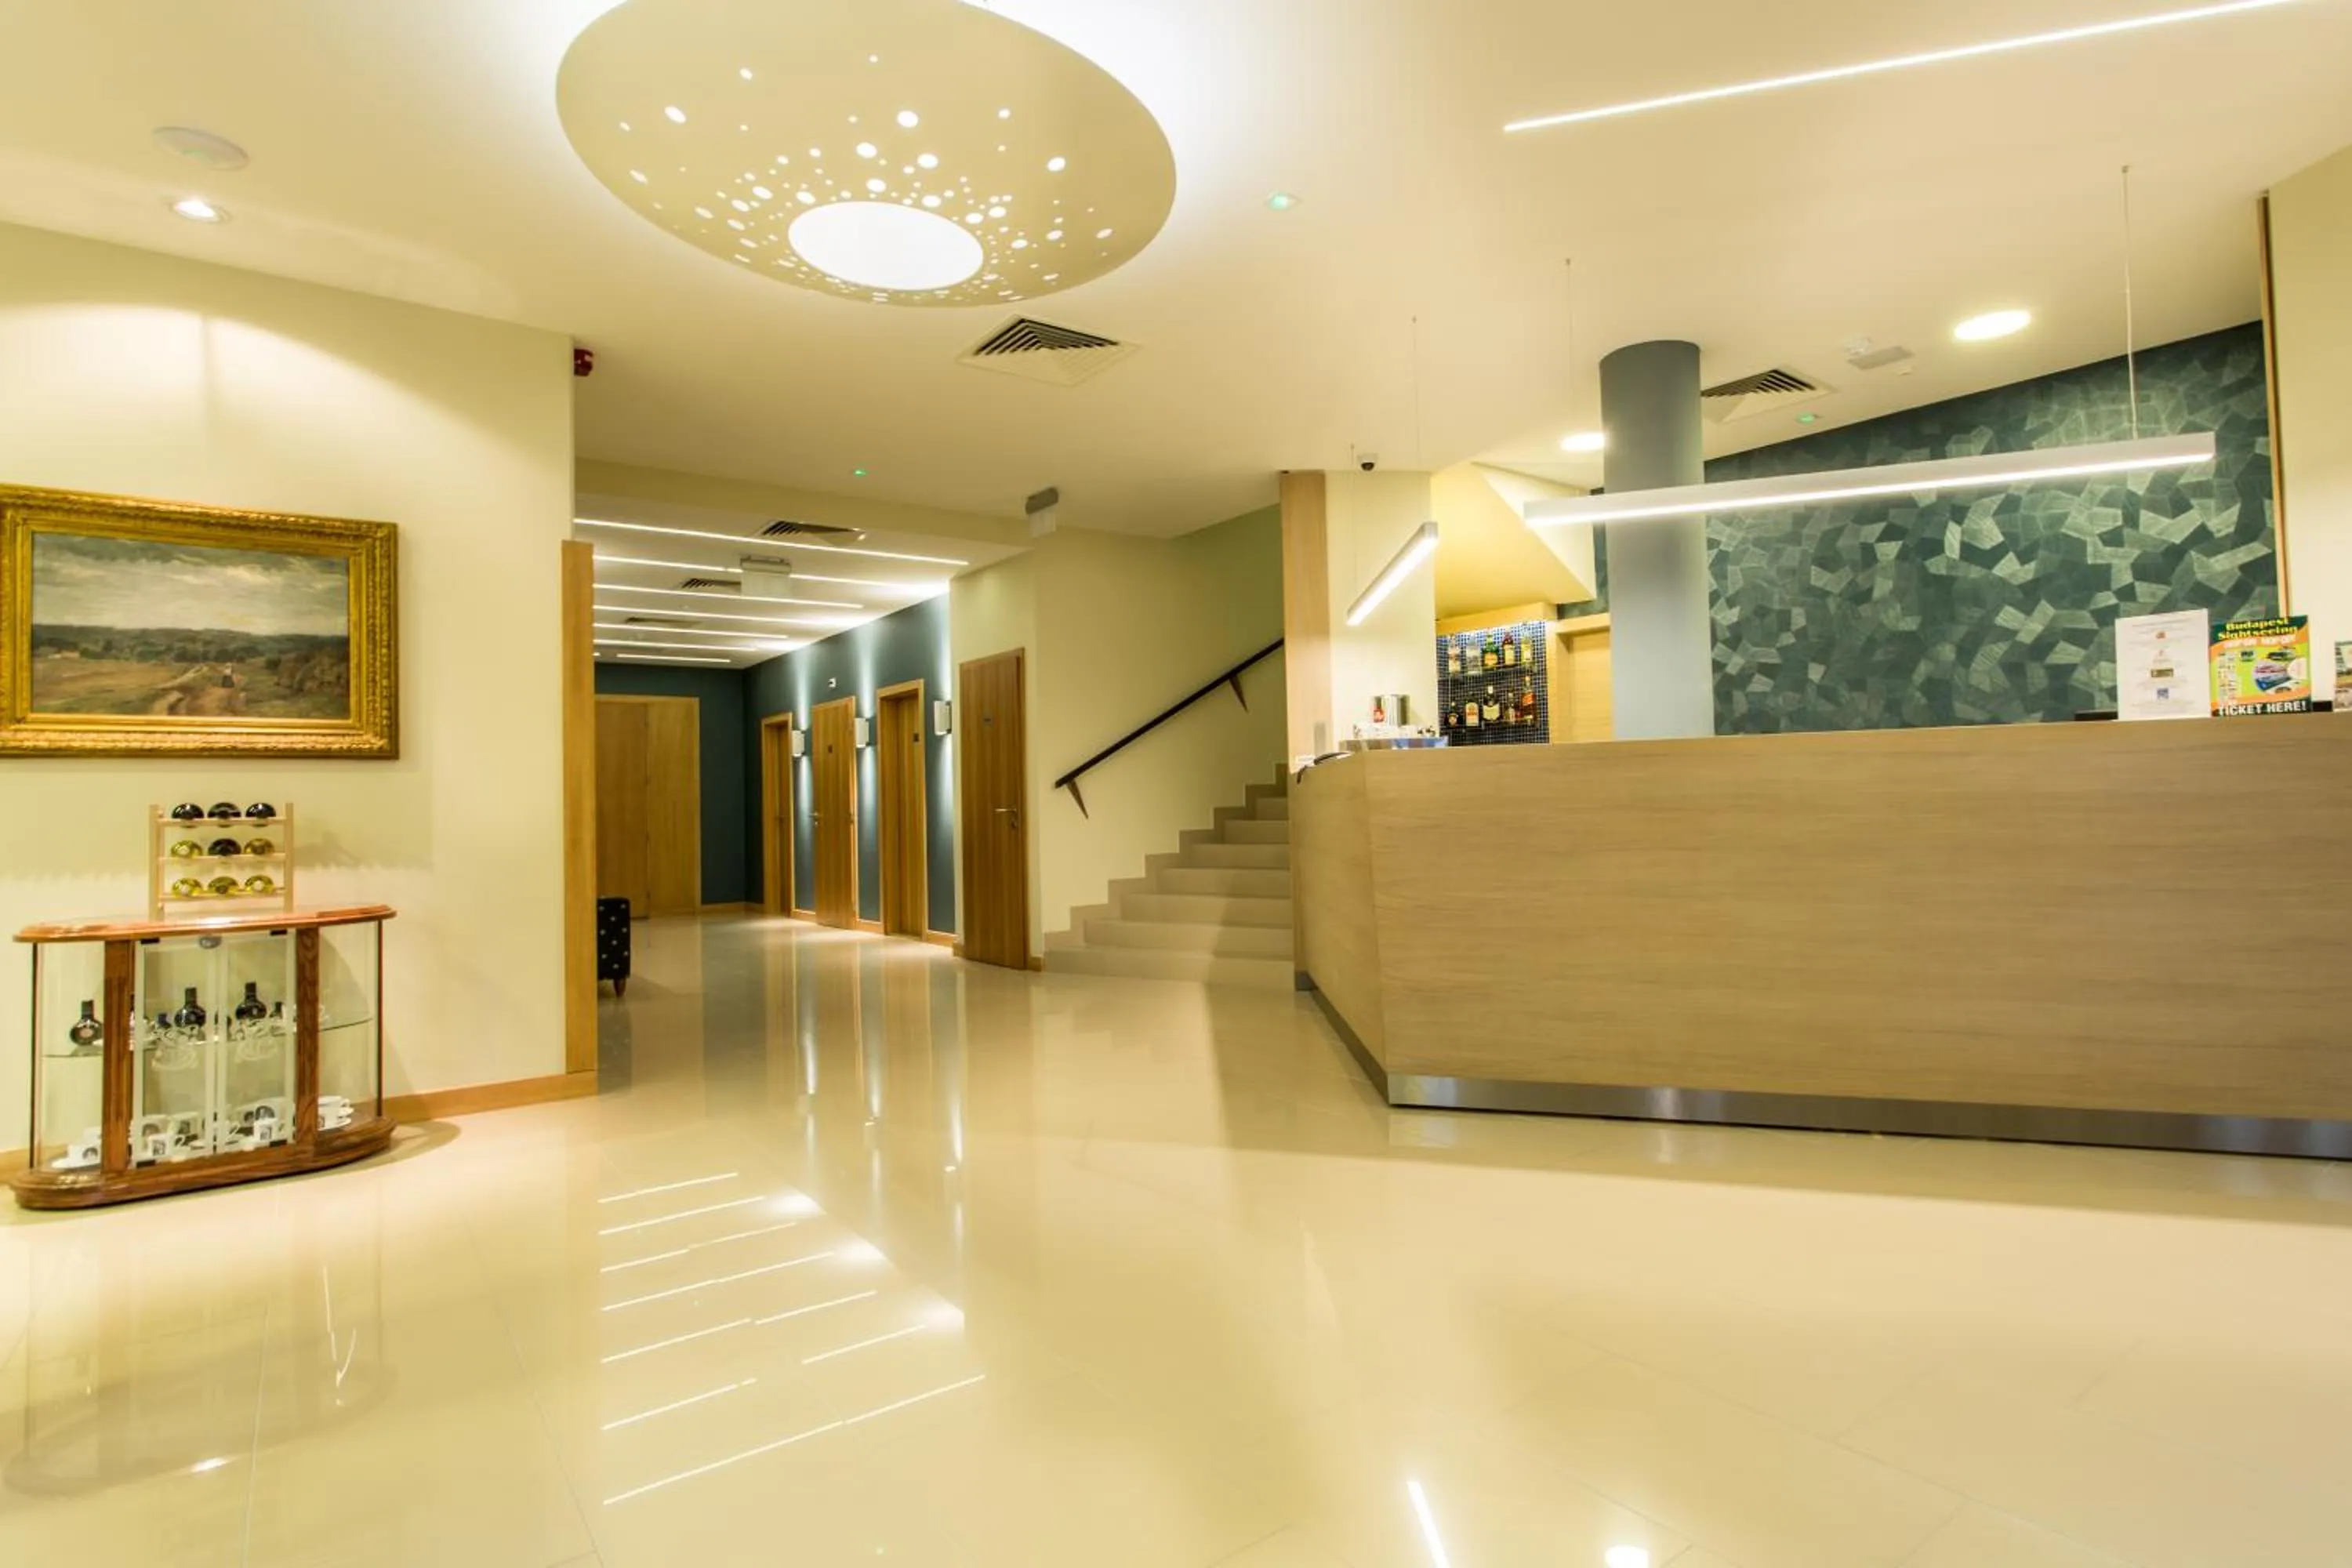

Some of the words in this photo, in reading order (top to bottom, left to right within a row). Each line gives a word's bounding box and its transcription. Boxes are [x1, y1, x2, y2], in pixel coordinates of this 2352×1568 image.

[2226, 617, 2288, 630] Budapest
[2218, 626, 2298, 641] Sightseeing
[2218, 704, 2263, 717] TICKET
[2267, 701, 2307, 713] HERE!
